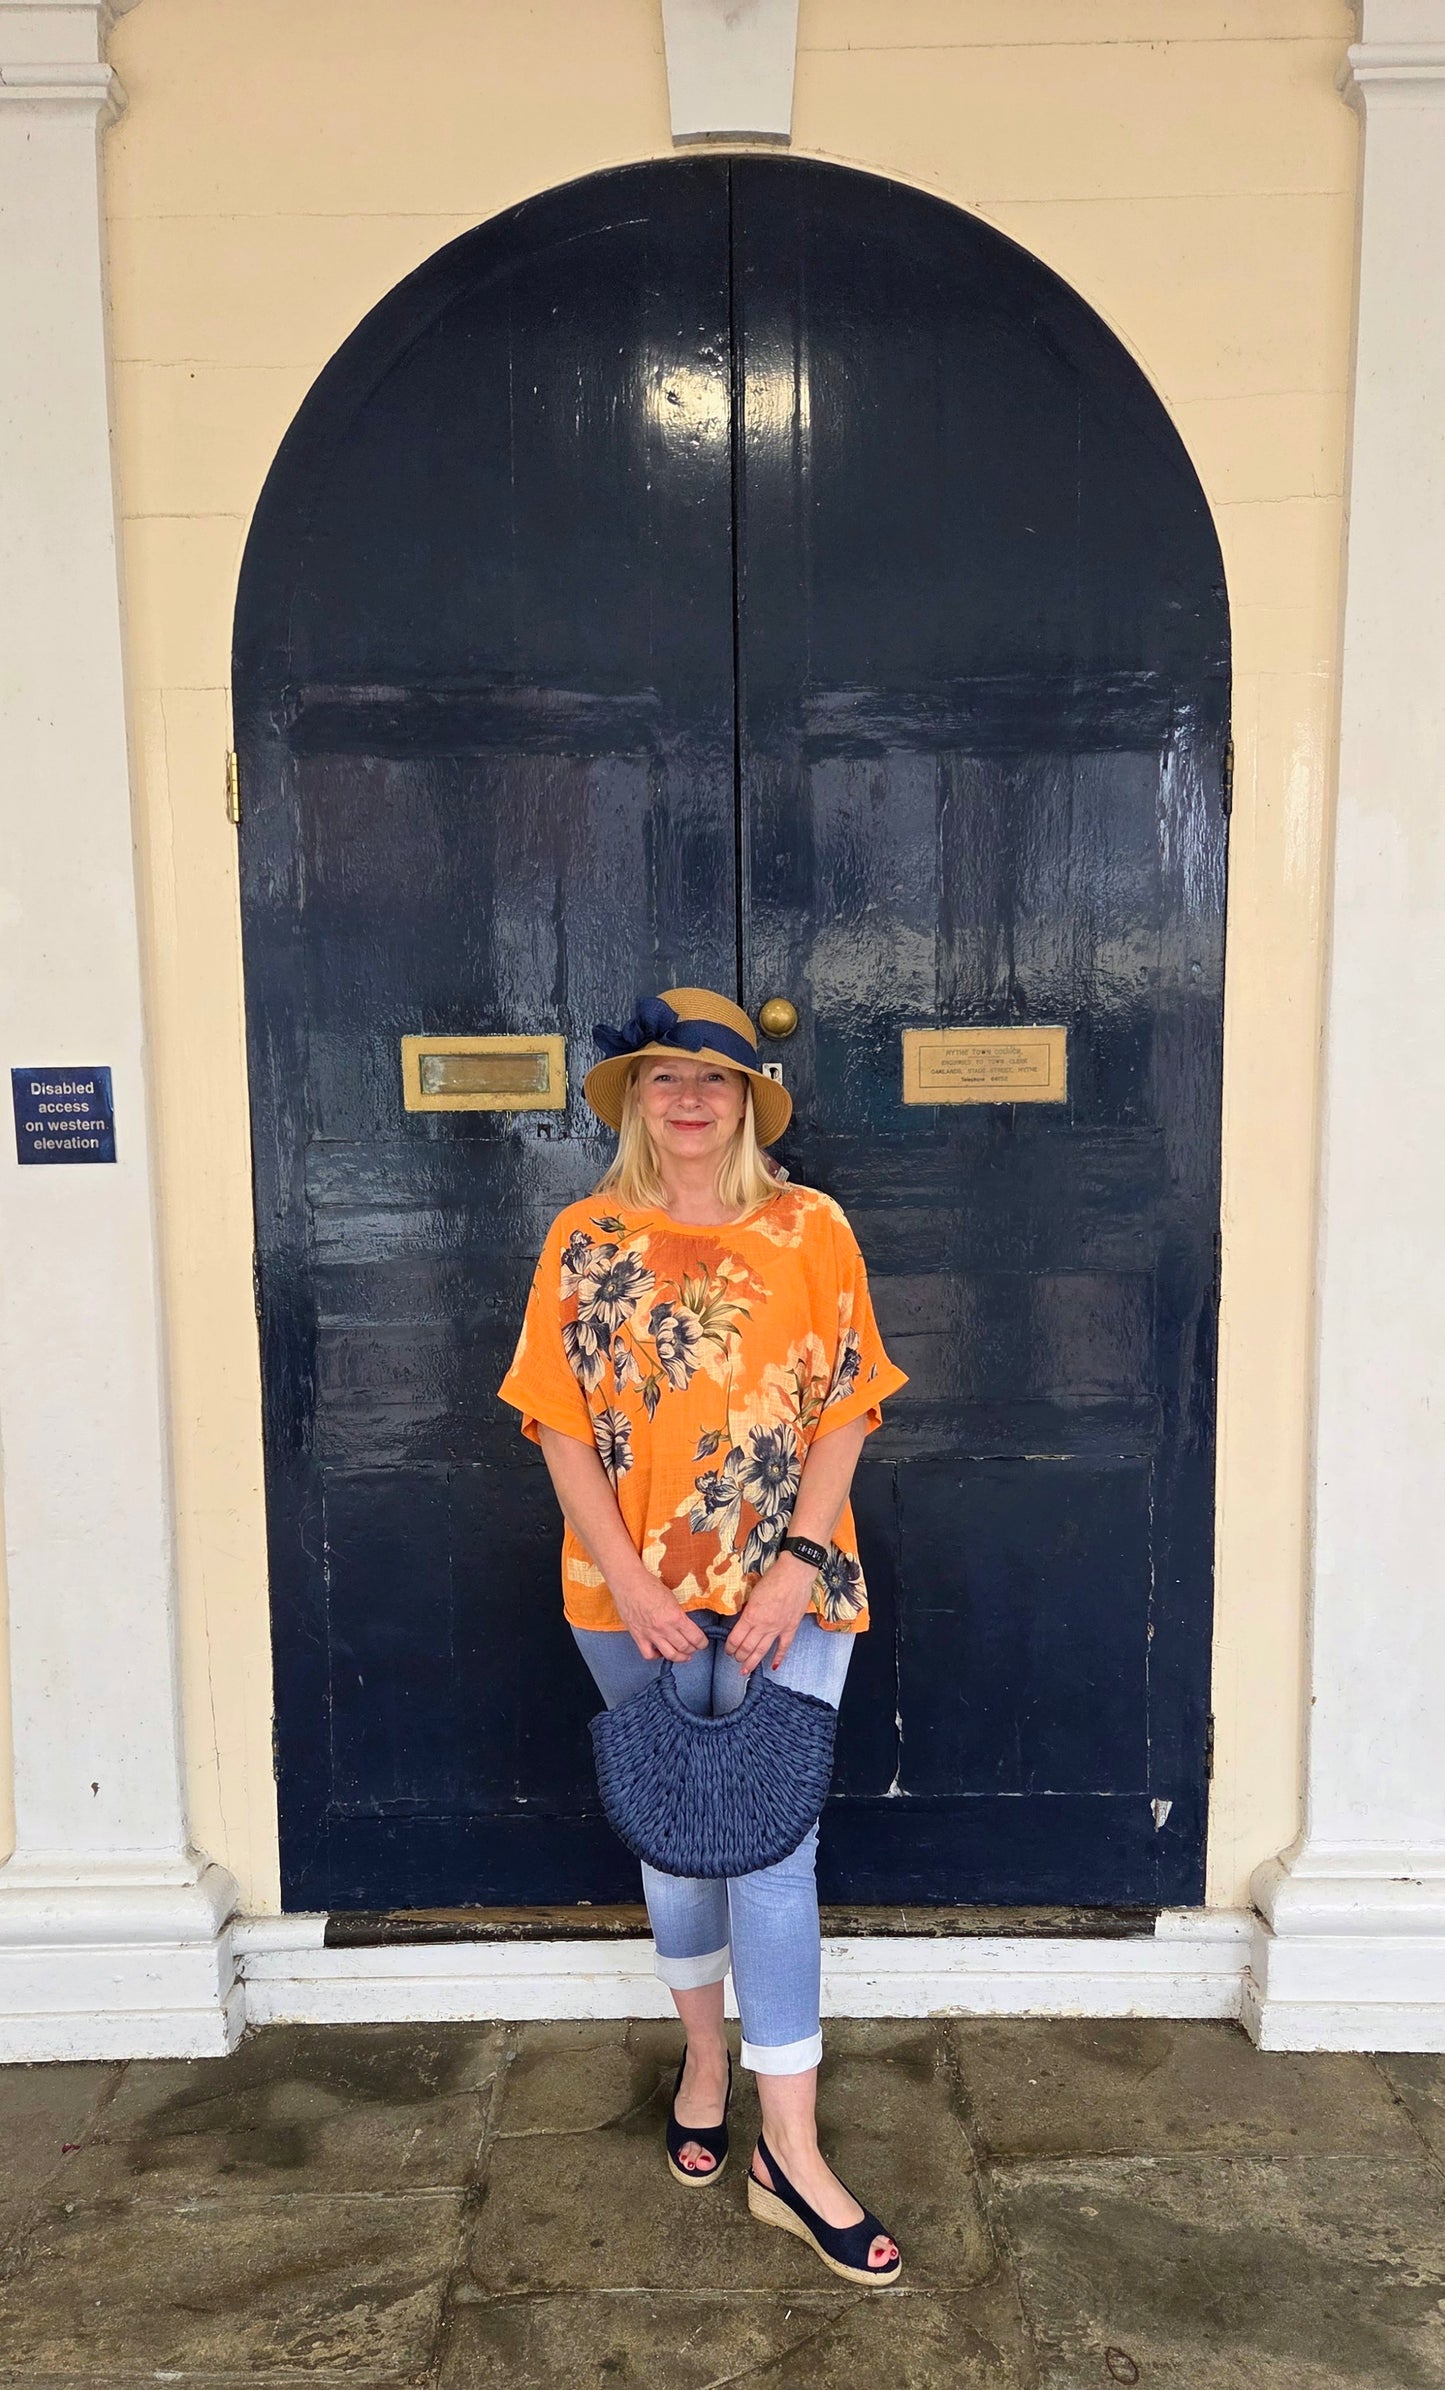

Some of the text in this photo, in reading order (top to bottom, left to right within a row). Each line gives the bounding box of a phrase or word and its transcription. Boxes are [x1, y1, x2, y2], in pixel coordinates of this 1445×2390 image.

[30, 1081, 94, 1095] Disabled
[38, 1103, 89, 1113] access
[25, 1119, 105, 1132] on western
[33, 1137, 99, 1149] elevation
